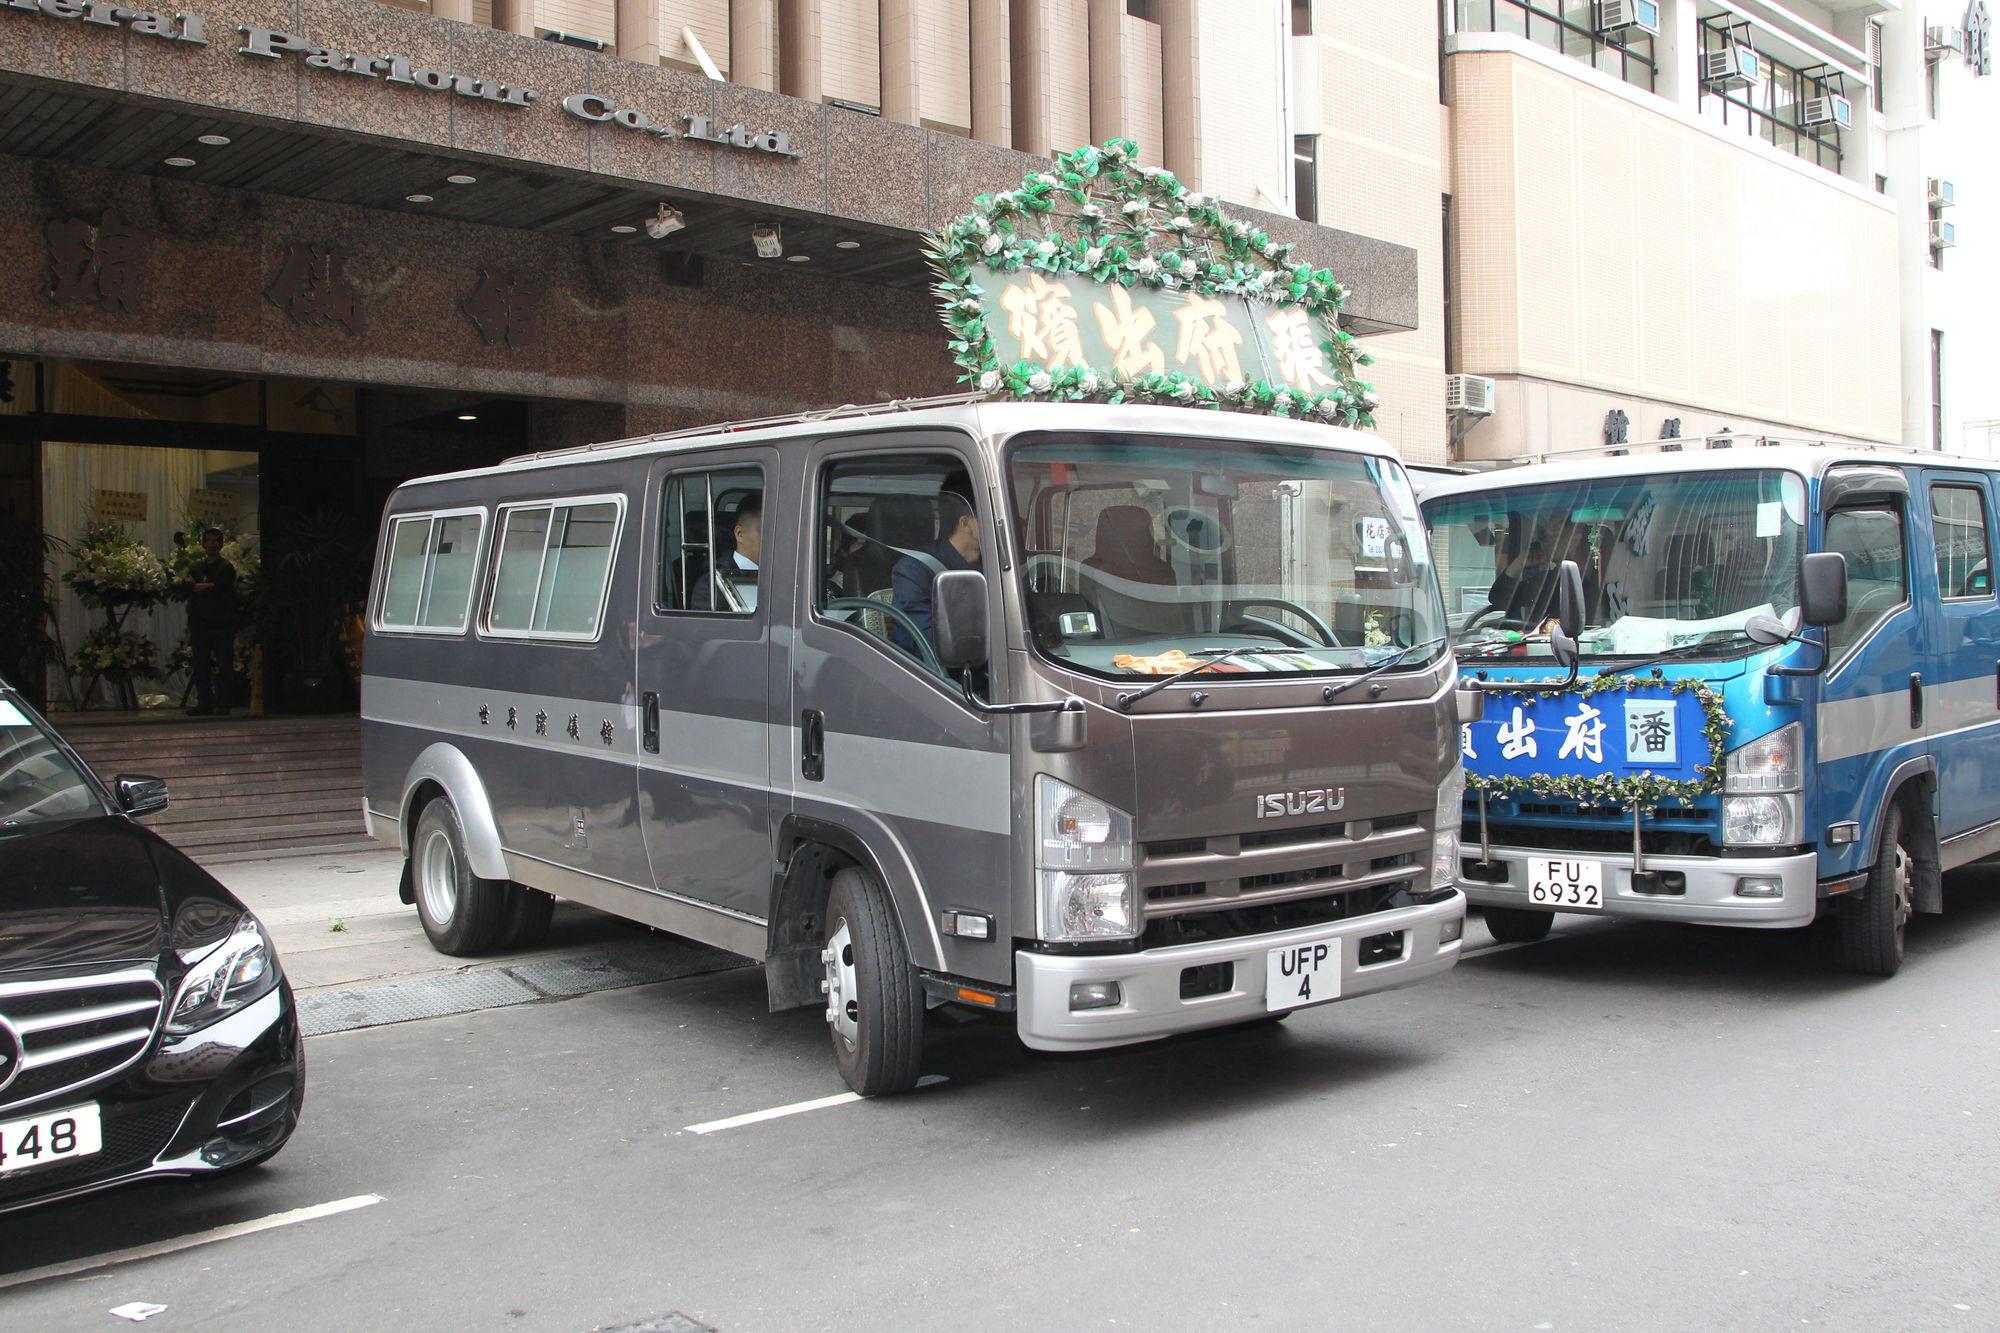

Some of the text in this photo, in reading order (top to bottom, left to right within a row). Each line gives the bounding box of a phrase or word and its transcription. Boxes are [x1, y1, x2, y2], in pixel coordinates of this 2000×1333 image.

[238, 24, 541, 108] Parlour
[1257, 788, 1345, 819] ISUZU
[1548, 861, 1580, 883] FU
[1533, 882, 1598, 905] 6932
[1280, 943, 1328, 977] UFP
[1298, 974, 1312, 1000] 4
[0, 1117, 77, 1166] 48
